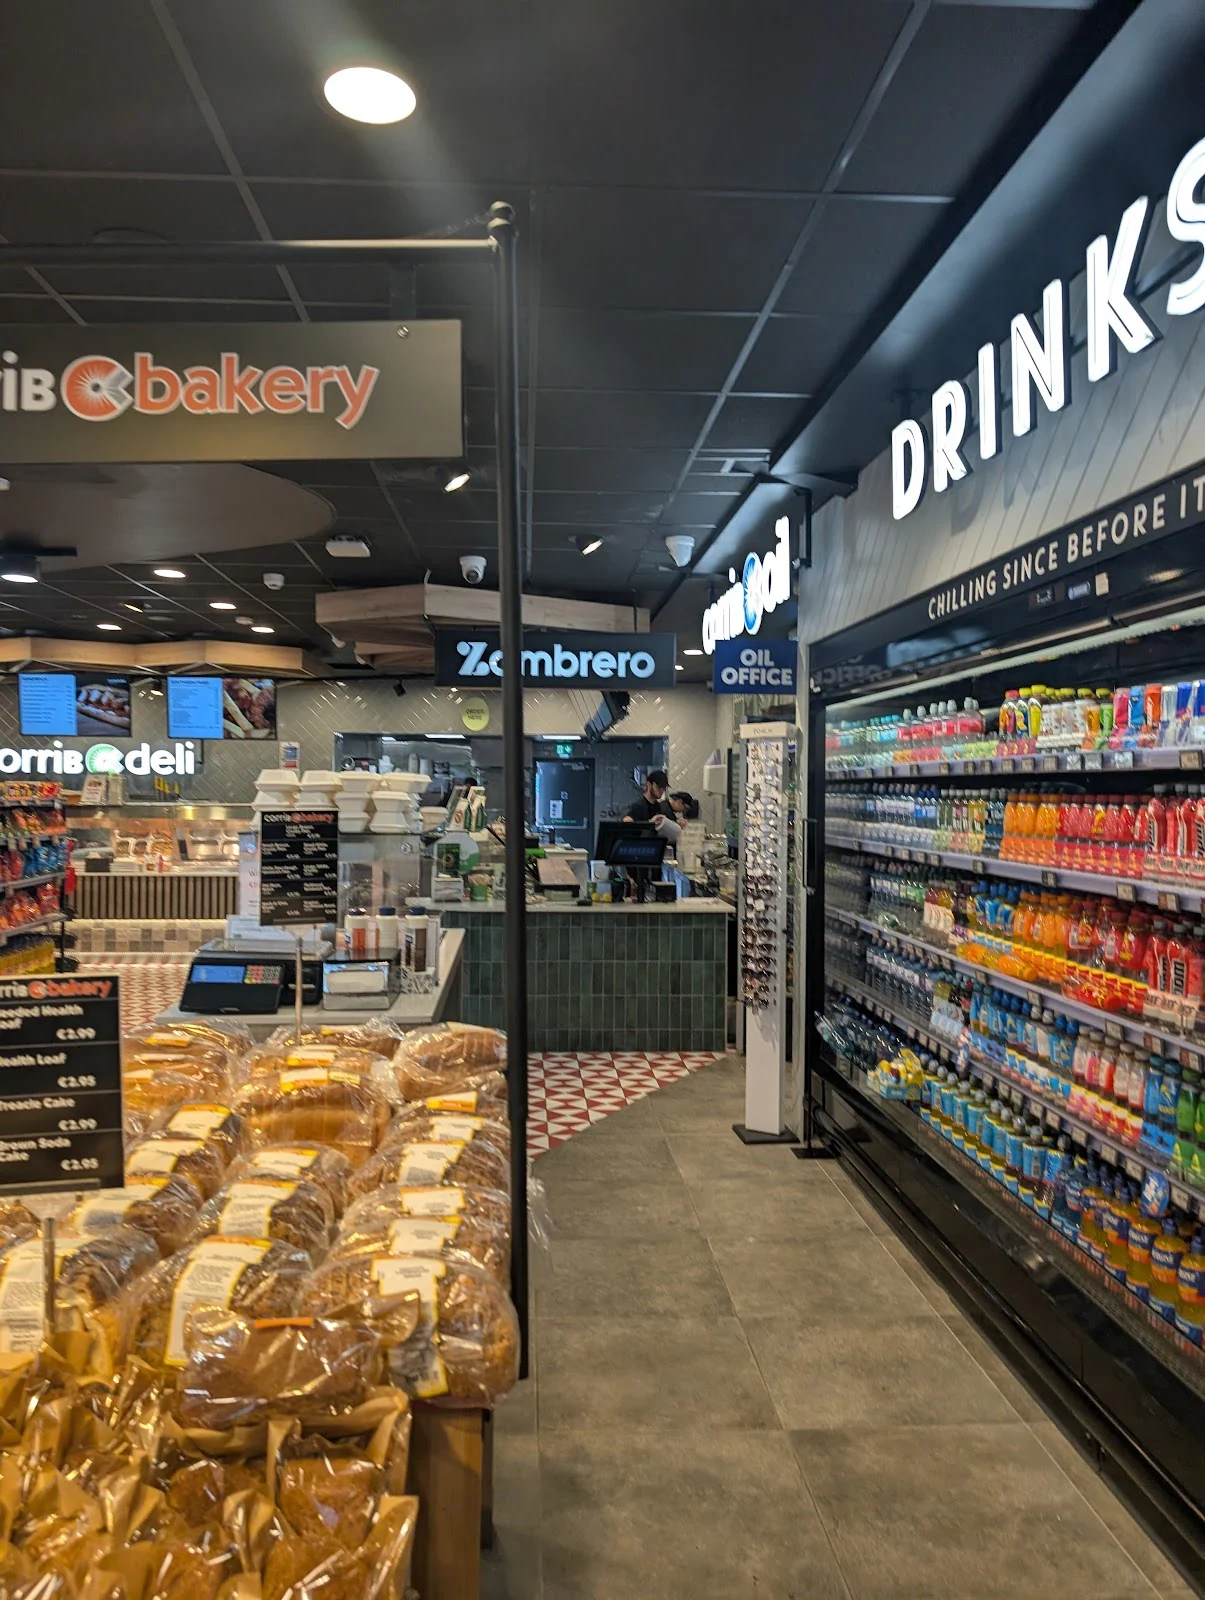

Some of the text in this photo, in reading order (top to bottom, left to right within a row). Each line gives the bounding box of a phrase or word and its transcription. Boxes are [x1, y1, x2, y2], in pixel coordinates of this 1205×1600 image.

[891, 135, 1205, 520] DRINKS
[134, 352, 380, 430] bakery
[928, 570, 997, 620] CHILLING
[1002, 541, 1058, 590] SINCE
[1067, 493, 1167, 564] BEFORE
[740, 649, 775, 667] OIL
[721, 668, 793, 686] OFFICE
[125, 741, 195, 775] deli
[47, 979, 112, 999] bakery
[41, 1004, 84, 1016] Health
[56, 1027, 96, 1040] €2.99
[0, 1052, 67, 1067] ealth Loaf
[57, 1074, 97, 1088] €2.95
[43, 1097, 76, 1108] Cake
[58, 1118, 97, 1131] €2.99
[38, 1137, 71, 1149] Soda
[60, 1158, 99, 1171] €2.95
